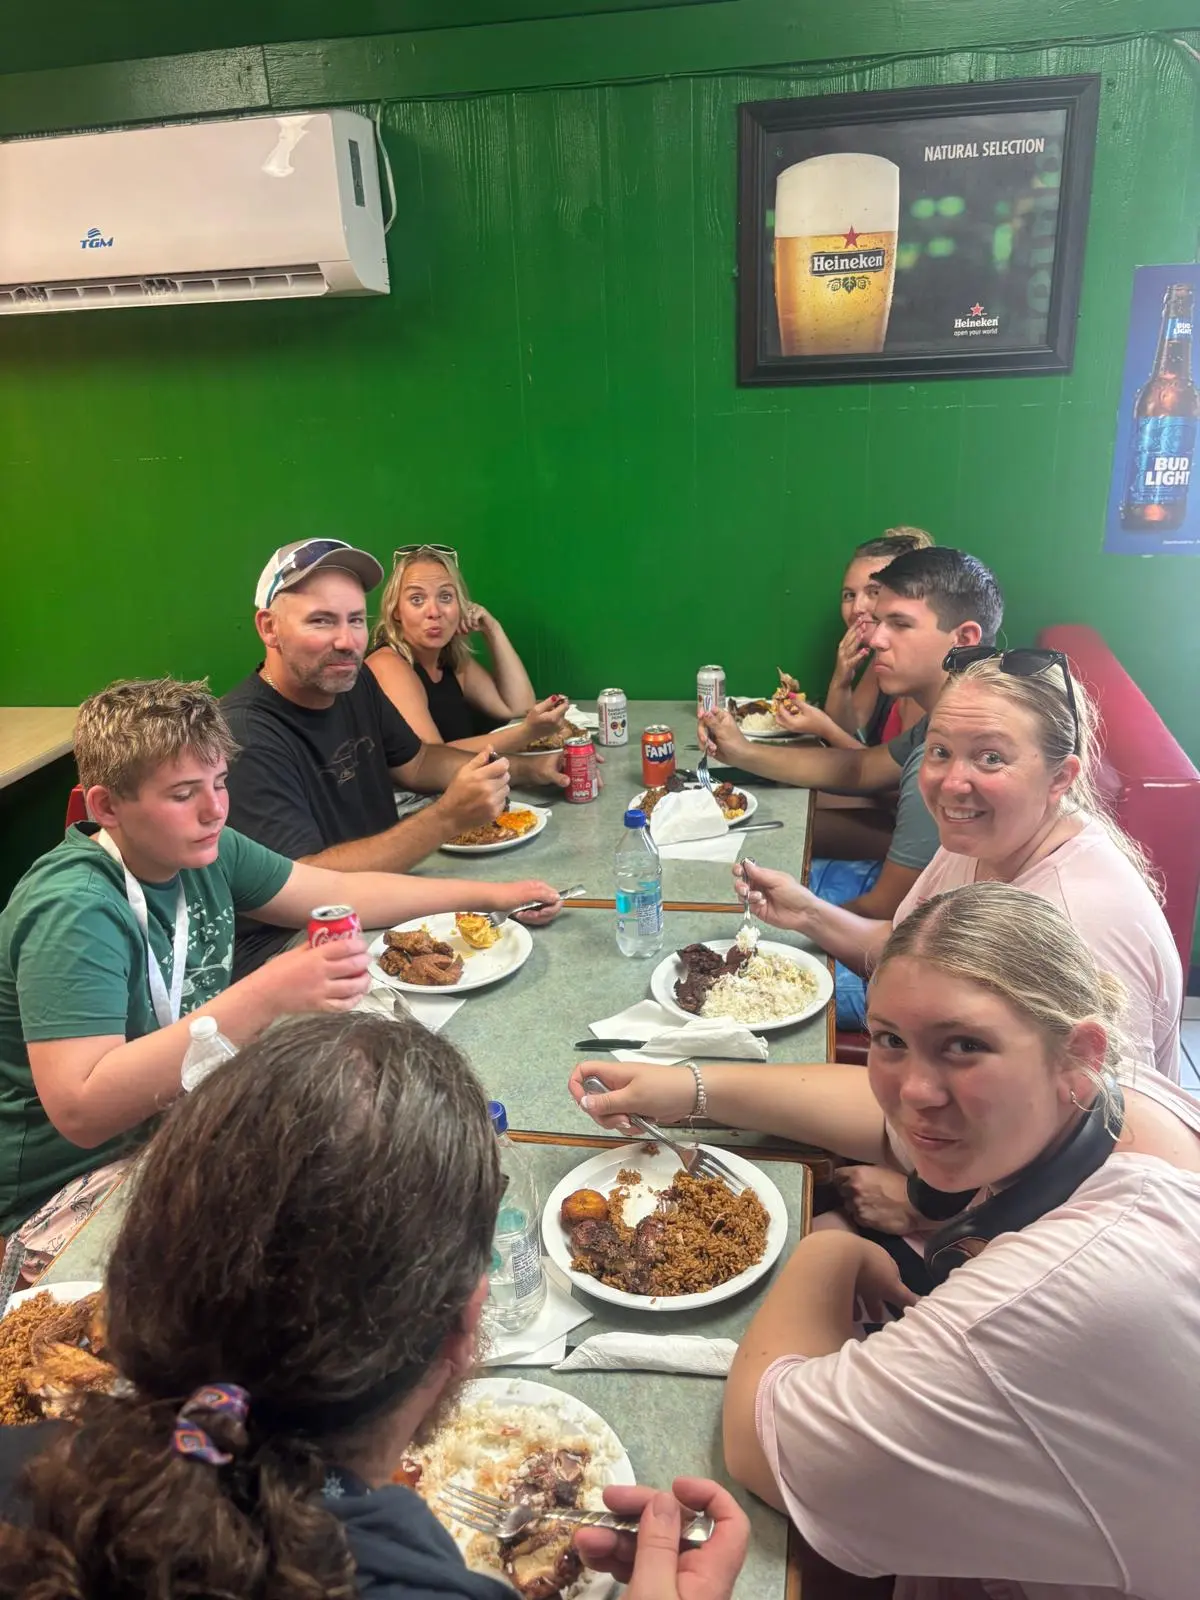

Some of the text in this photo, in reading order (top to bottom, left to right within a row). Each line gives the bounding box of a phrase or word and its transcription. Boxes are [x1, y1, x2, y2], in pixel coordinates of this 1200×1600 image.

[924, 137, 1045, 162] NATURAL SELECTION
[80, 237, 114, 249] TGM
[813, 253, 883, 272] Heineken
[953, 317, 999, 328] Heineken
[1154, 457, 1189, 471] BUD
[1144, 471, 1191, 486] LIGHT
